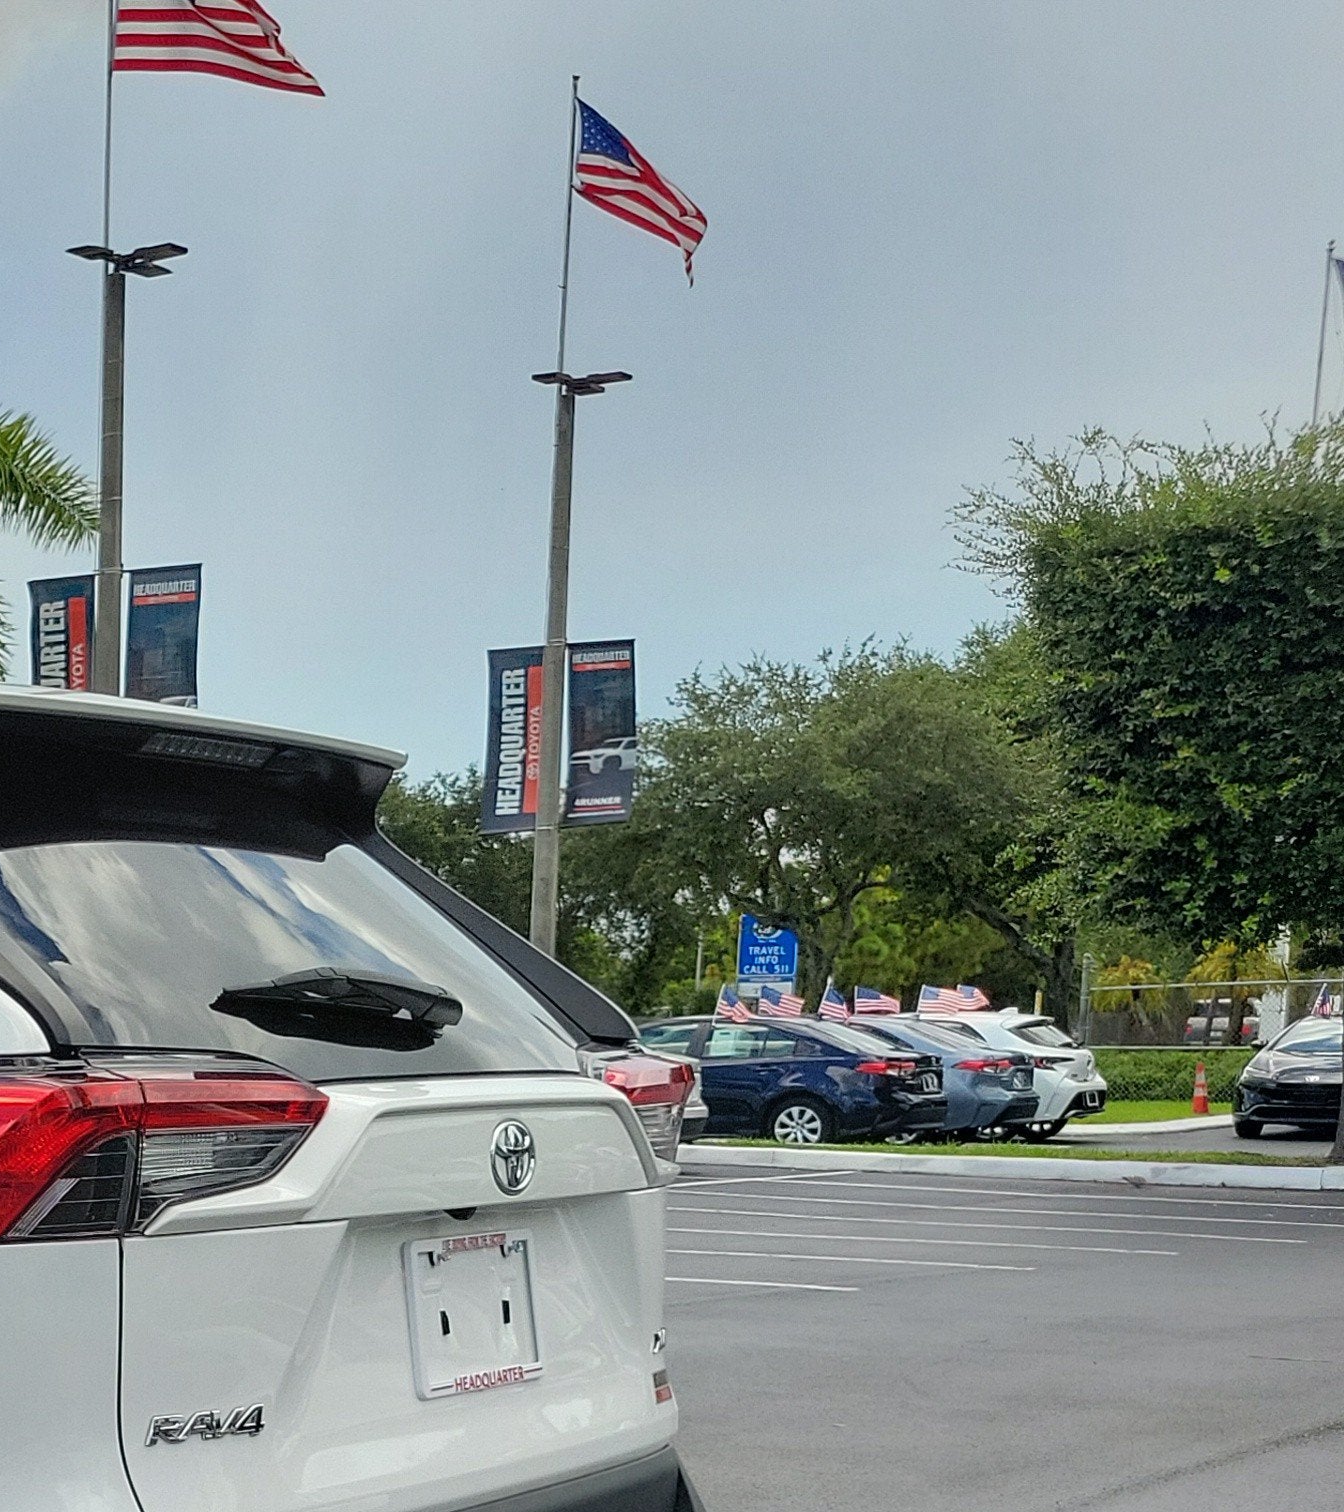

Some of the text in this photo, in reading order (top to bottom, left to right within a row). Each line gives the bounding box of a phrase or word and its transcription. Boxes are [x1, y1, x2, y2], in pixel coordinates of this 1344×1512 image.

[71, 643, 86, 691] YOTA
[494, 668, 526, 816] HEADQUARTER
[527, 706, 541, 764] TOYOTA
[748, 946, 787, 956] TRAVEL
[754, 955, 779, 965] INFO
[743, 964, 789, 974] CALL 511
[454, 1365, 524, 1391] HEADQUARTER
[145, 1403, 266, 1447] RAV4
